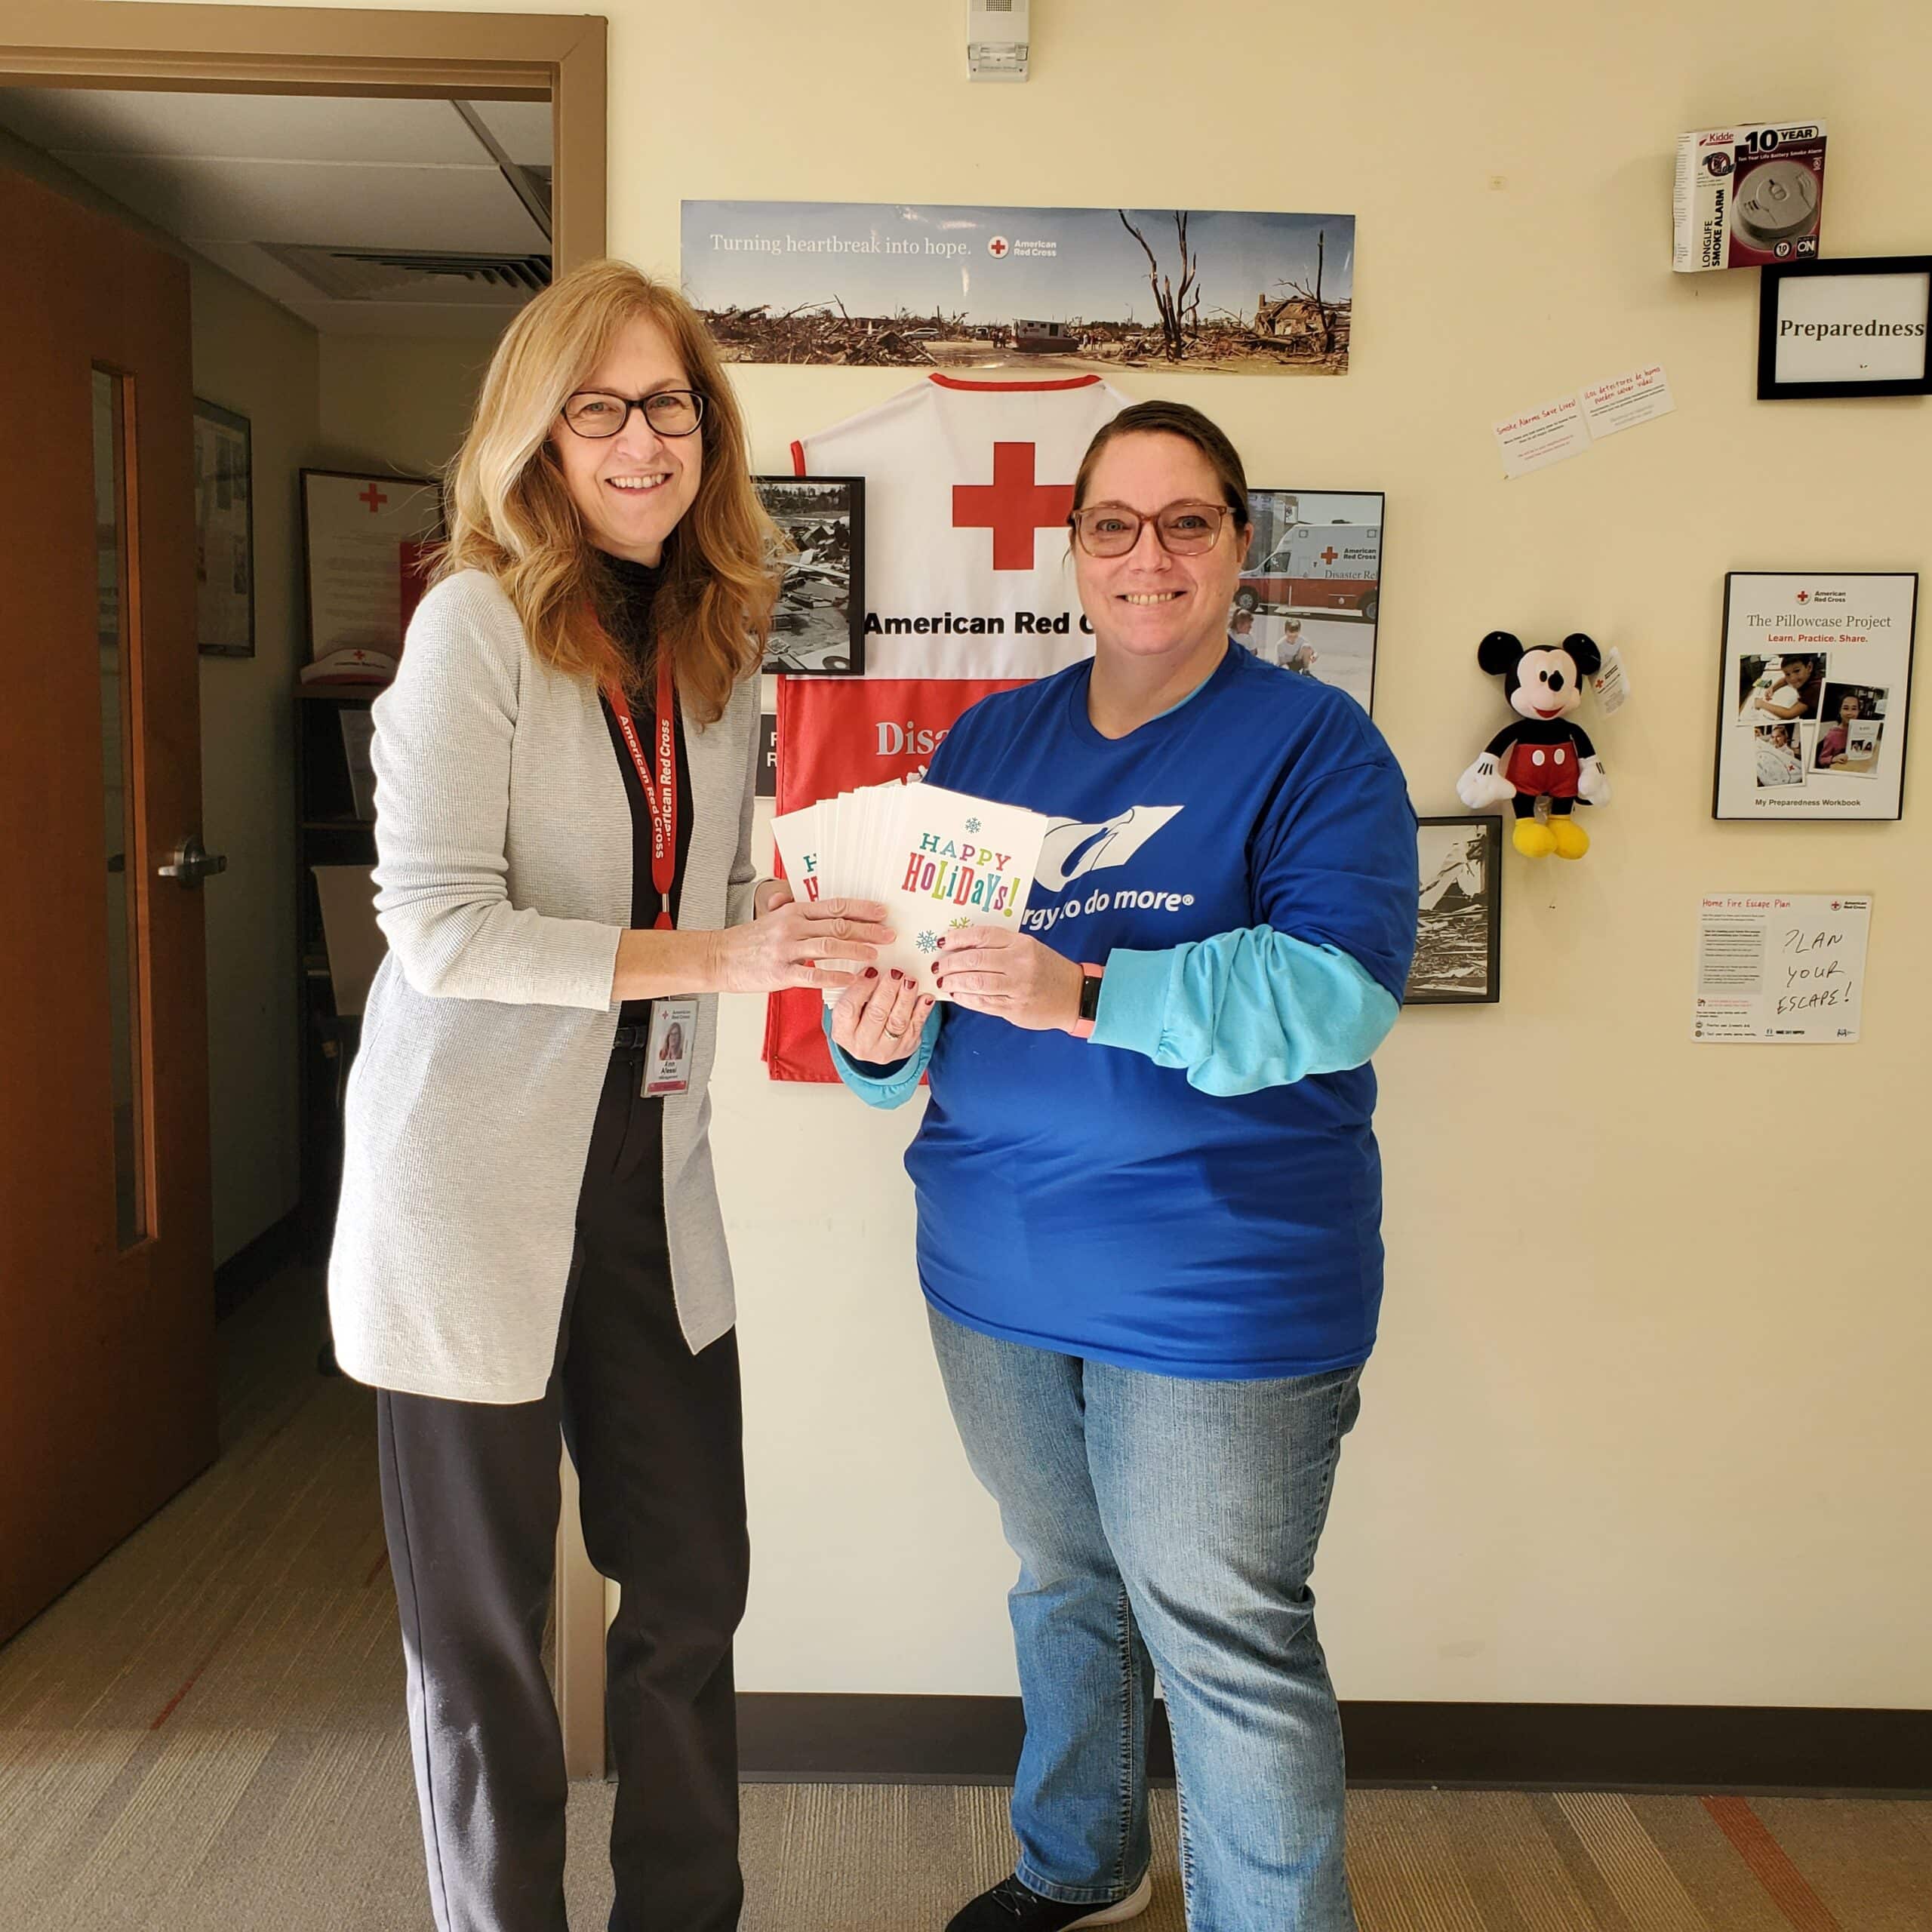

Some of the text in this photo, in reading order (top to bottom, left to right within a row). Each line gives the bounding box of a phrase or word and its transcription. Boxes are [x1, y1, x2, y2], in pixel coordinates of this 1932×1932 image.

[1709, 133, 1734, 142] Kidde
[1745, 129, 1813, 152] 10 YEAR
[1712, 189, 1724, 266] SMOKE ALARM
[710, 234, 971, 258] Turning heartbreak into hope.
[1014, 240, 1057, 248] American
[1703, 220, 1712, 267] LONGLIFE
[1798, 241, 1814, 252] ON
[1780, 319, 1925, 341] Preparedness
[1542, 408, 1558, 417] Save
[1325, 570, 1362, 579] Disaster
[864, 612, 1004, 635] American
[1014, 612, 1070, 635] Red
[1746, 614, 1892, 630] The Pillowcase Project
[1768, 634, 1795, 642] Learn.
[1839, 634, 1869, 643] Share.
[660, 718, 670, 755] Cross
[660, 758, 672, 786] Red
[1755, 798, 1767, 807] My
[1769, 798, 1820, 807] Preparedness
[647, 786, 663, 859] Red Cross
[919, 832, 1012, 872] HAPPY
[1084, 889, 1110, 915] do
[1703, 898, 1791, 909] Home Fire Escape Plan
